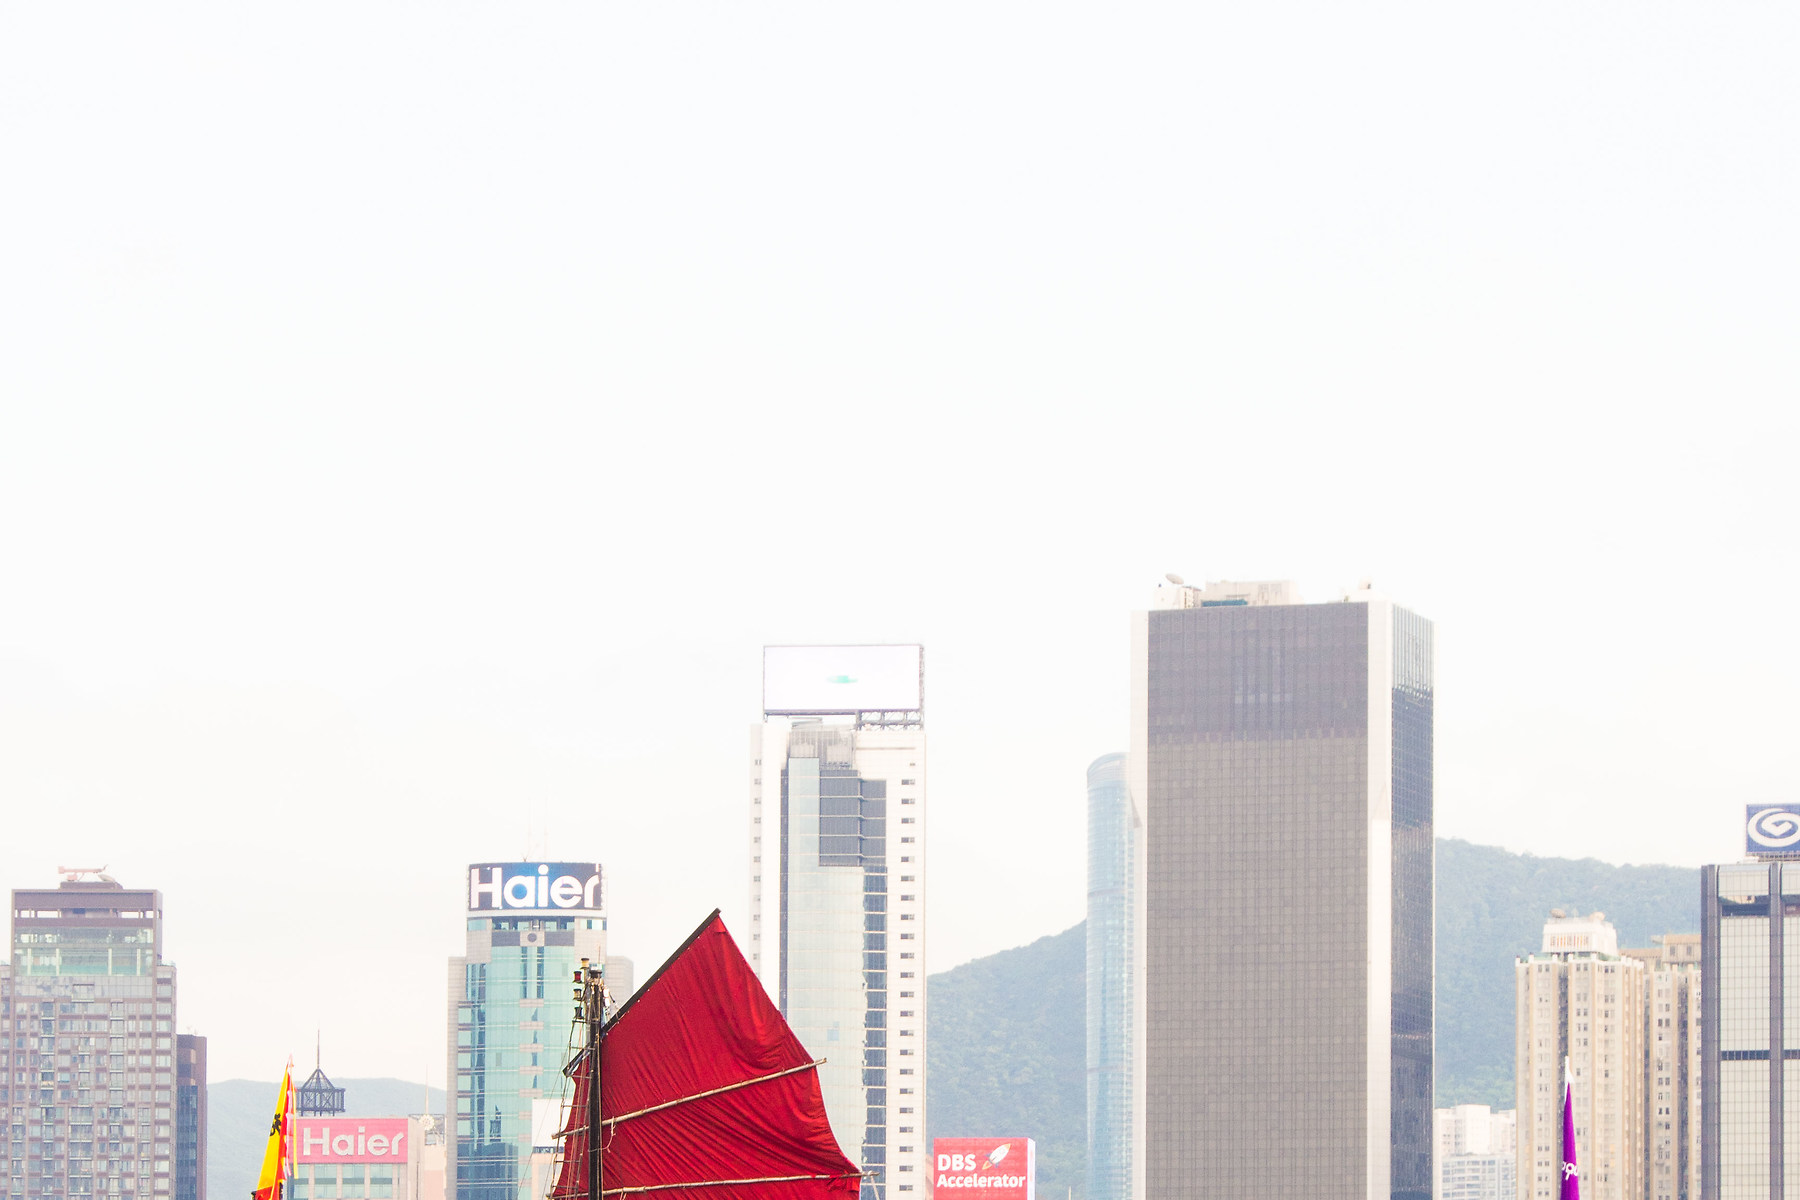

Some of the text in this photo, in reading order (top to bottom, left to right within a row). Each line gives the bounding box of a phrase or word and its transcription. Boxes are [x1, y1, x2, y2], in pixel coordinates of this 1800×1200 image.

[470, 864, 600, 909] Haier
[303, 1126, 404, 1156] Haier
[937, 1154, 977, 1171] DBS
[936, 1173, 1026, 1188] Accelerator
